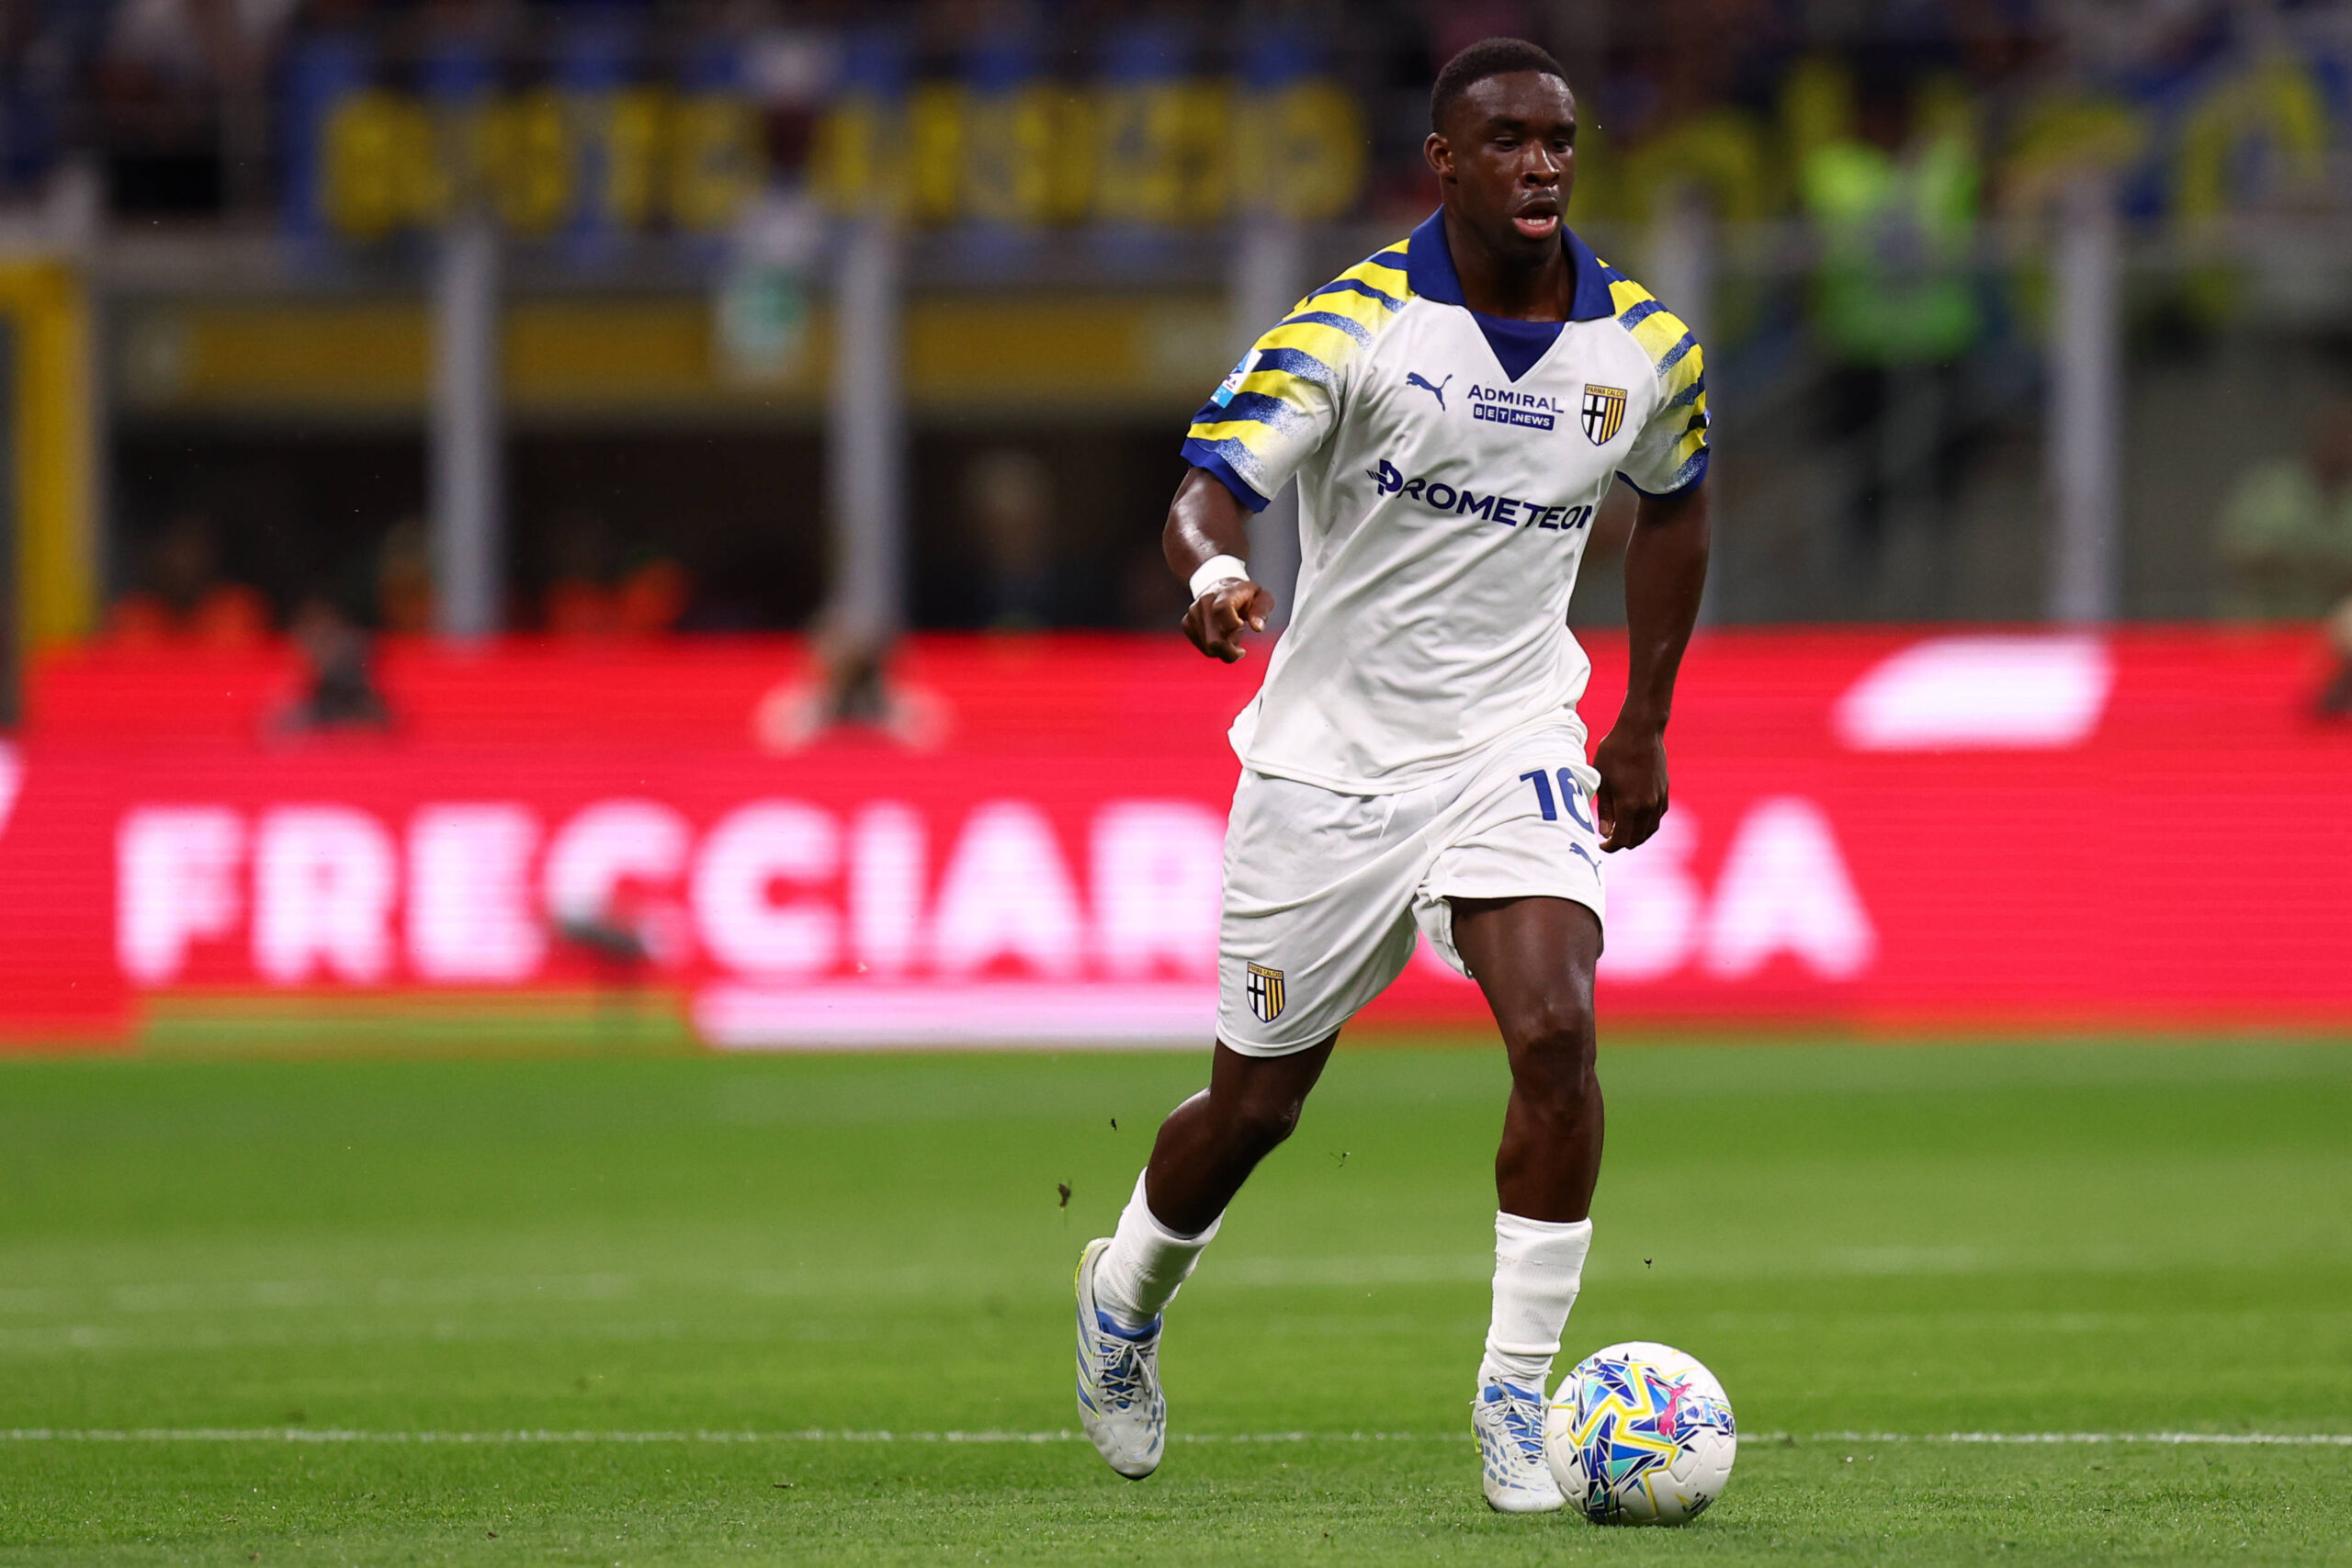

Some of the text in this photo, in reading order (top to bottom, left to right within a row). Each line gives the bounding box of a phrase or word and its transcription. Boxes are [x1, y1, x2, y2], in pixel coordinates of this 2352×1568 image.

[1586, 386, 1625, 398] PARMA CALCIO
[1467, 384, 1565, 414] ADMIRAL
[1263, 969, 1282, 979] CALCIO
